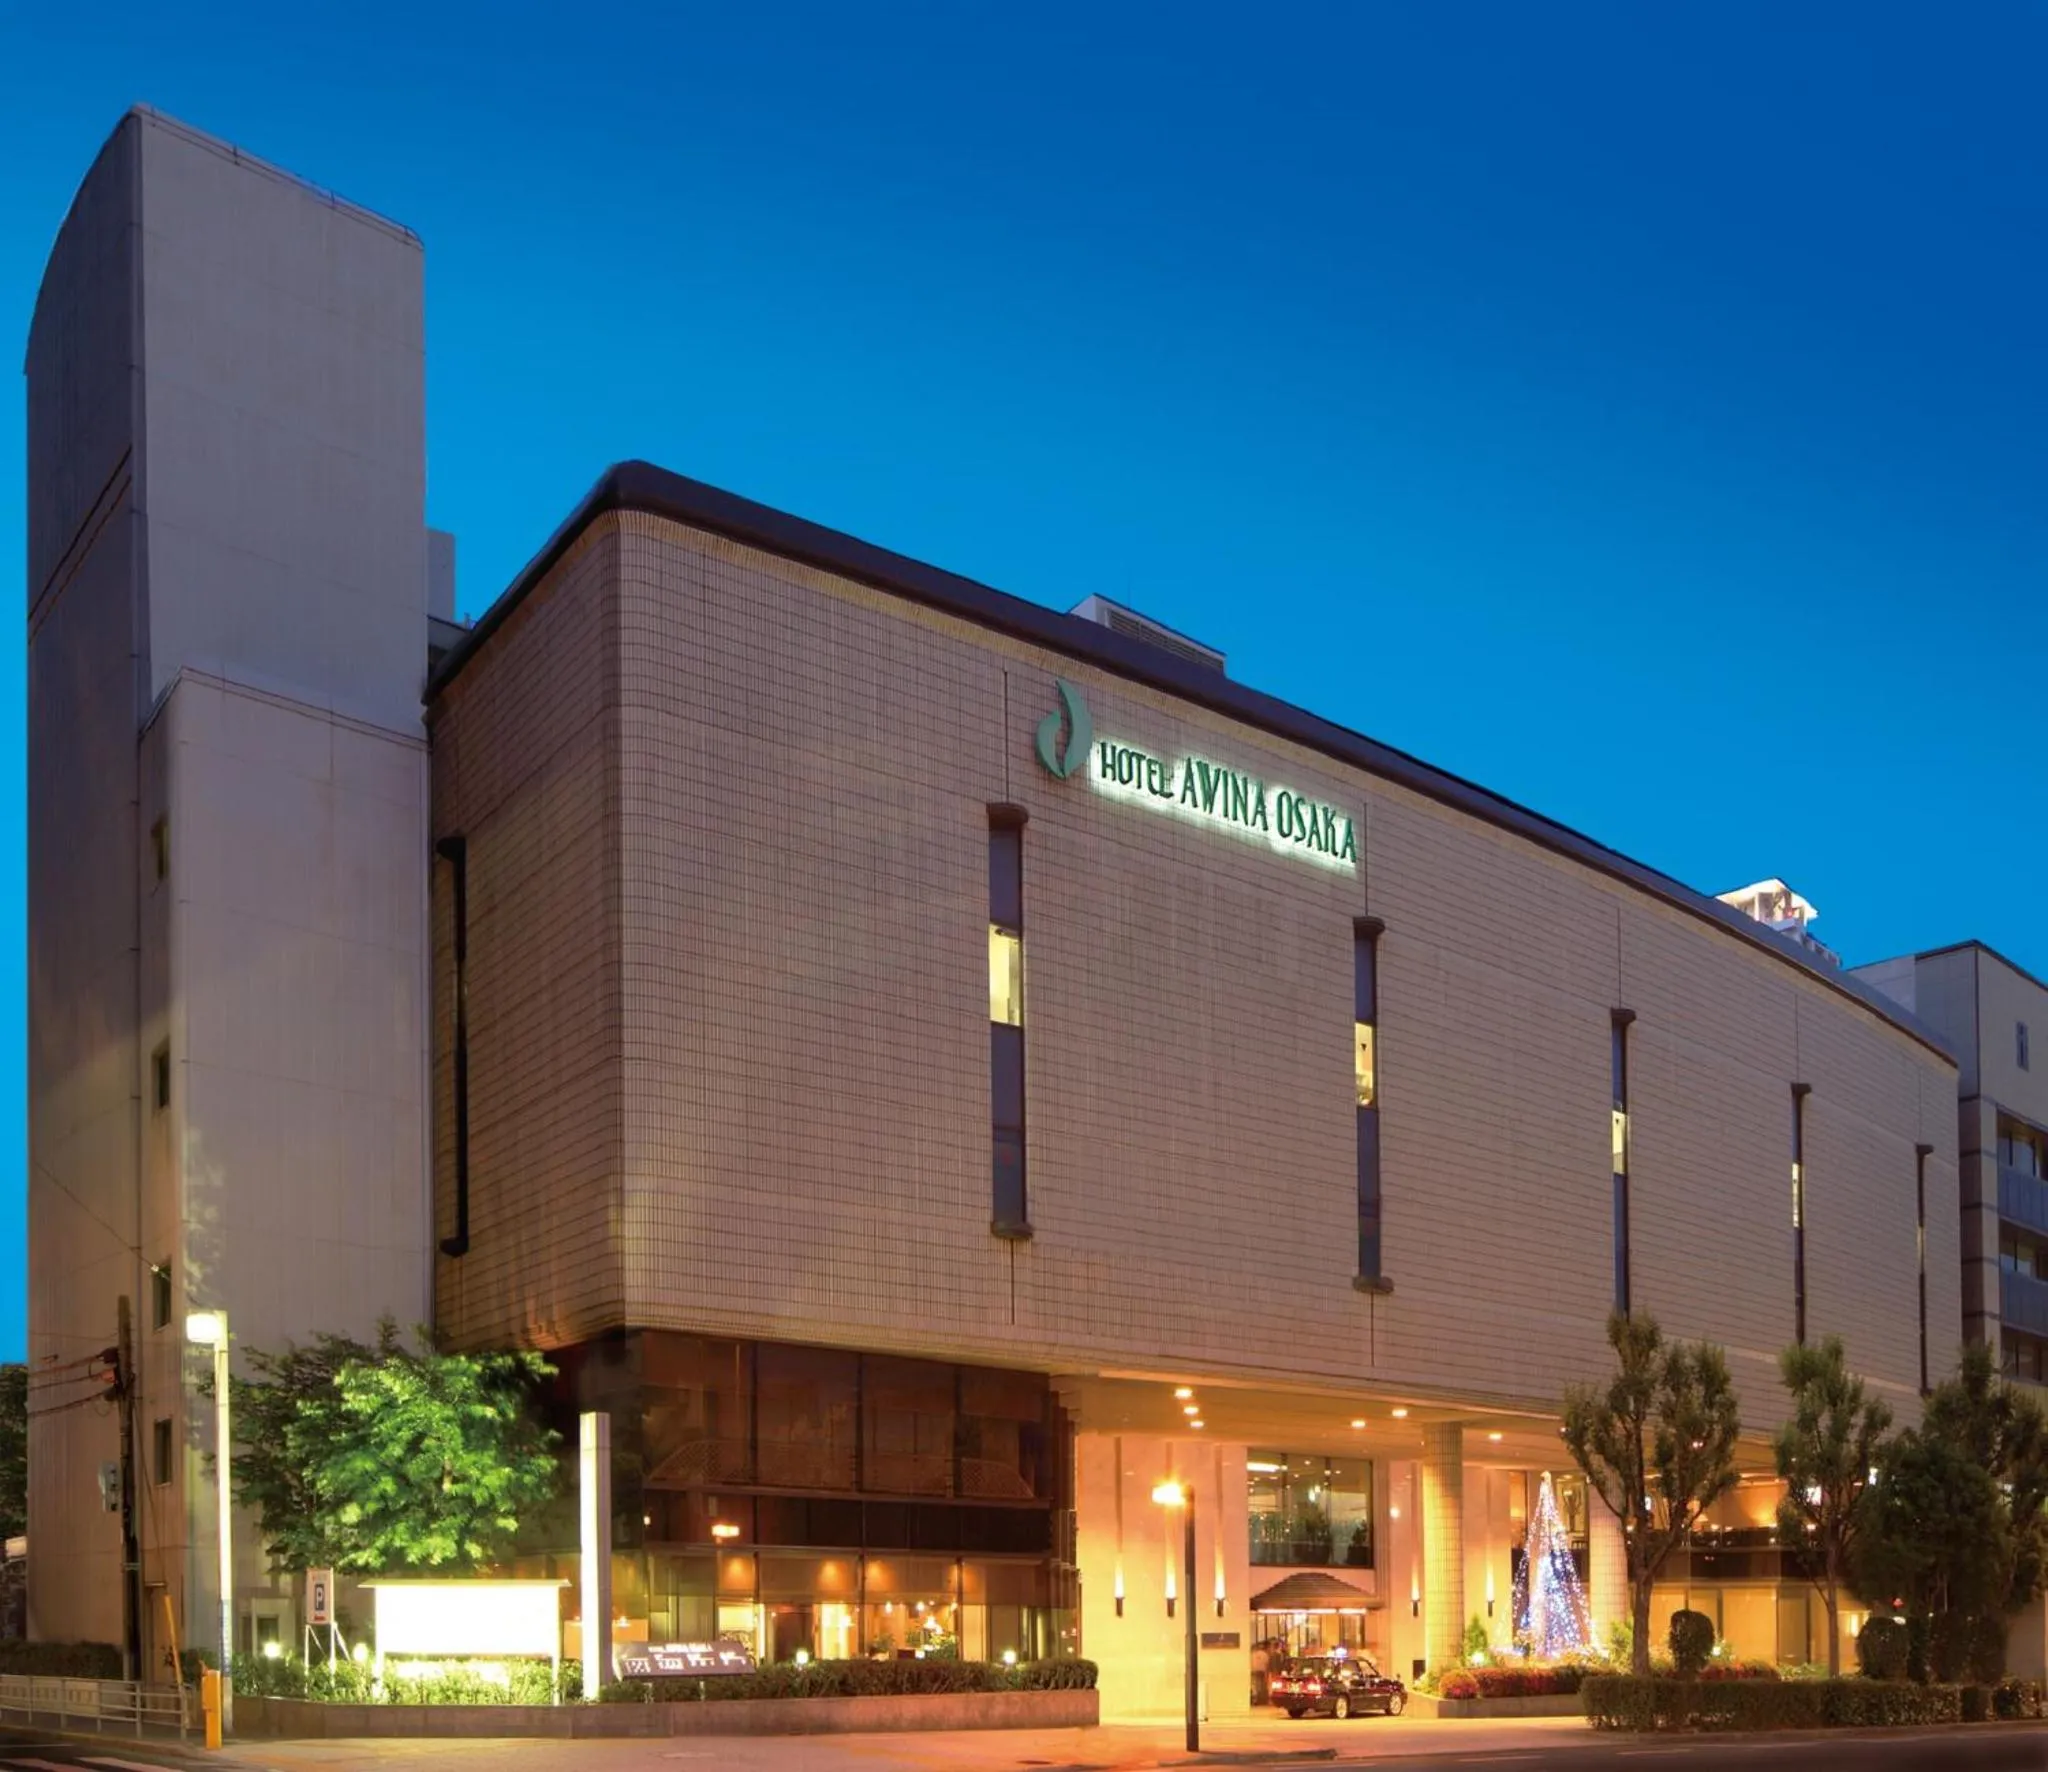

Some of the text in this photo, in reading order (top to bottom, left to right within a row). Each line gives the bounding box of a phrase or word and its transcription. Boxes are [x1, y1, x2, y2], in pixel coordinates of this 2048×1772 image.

[1100, 742, 1357, 863] HOTEL AWINA OSAKA
